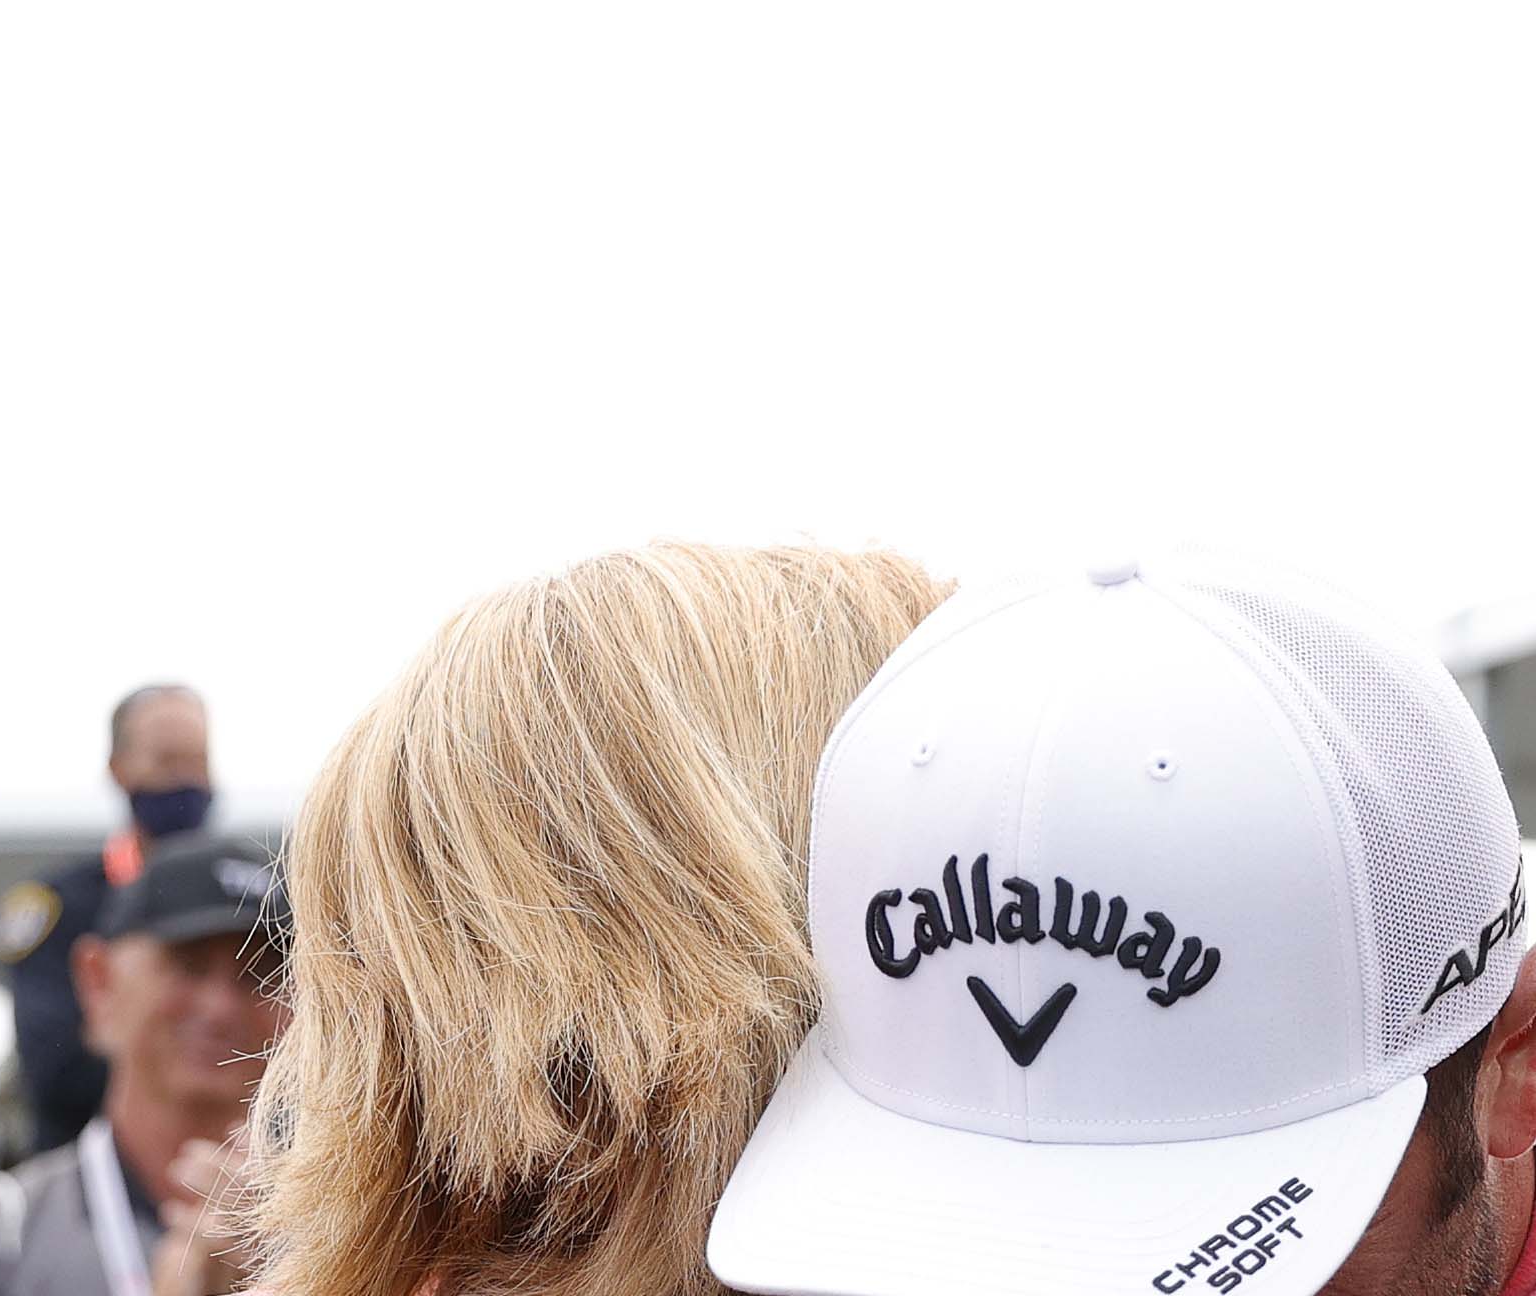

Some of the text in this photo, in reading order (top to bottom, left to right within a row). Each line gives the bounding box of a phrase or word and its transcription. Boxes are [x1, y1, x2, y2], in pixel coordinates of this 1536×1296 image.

[865, 852, 1221, 1007] Callaway
[1421, 855, 1526, 1016] APE
[1152, 1177, 1314, 1295] CHROME
[1206, 1216, 1304, 1296] SOFT
